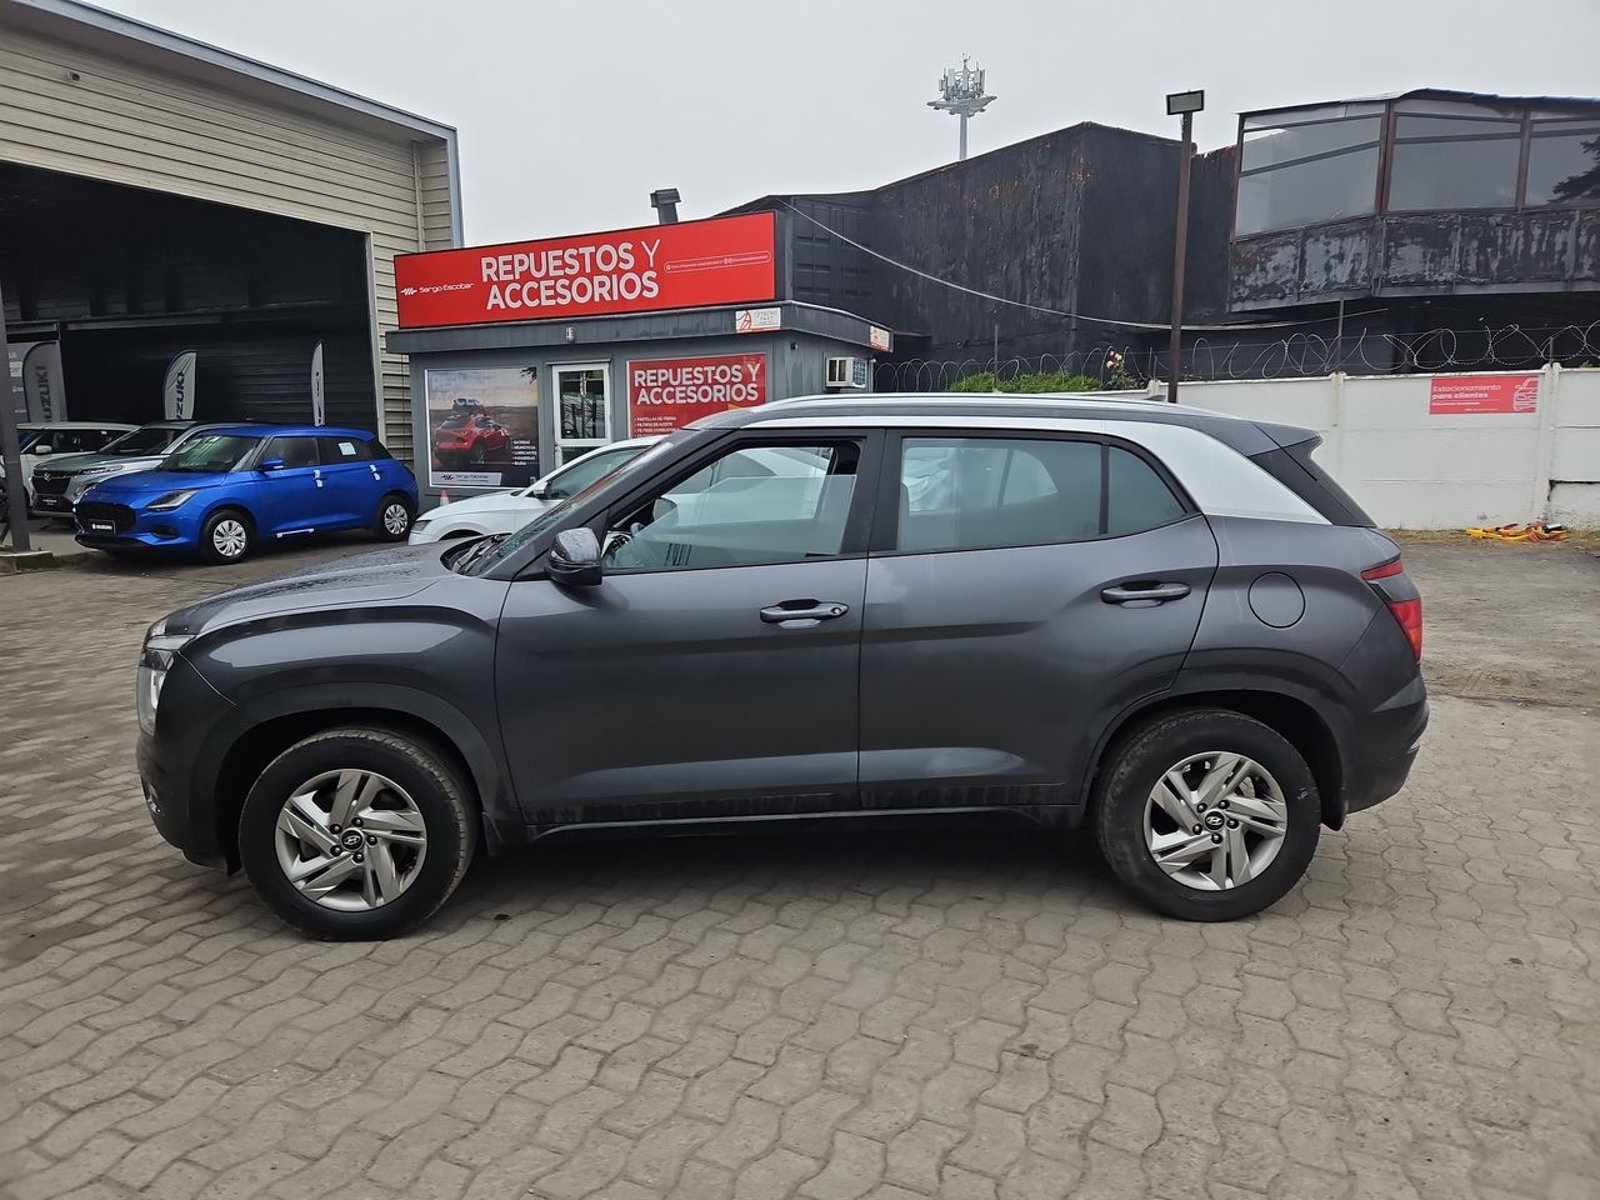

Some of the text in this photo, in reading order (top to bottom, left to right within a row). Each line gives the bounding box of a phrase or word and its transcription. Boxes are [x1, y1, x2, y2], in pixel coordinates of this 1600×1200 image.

[480, 243, 634, 282] REPUESTOS
[640, 239, 661, 268] Y
[443, 282, 475, 292] Escobar
[485, 271, 660, 311] ACCESORIOS
[634, 362, 761, 387] REPUESTOS Y
[35, 365, 52, 422] UZUKI
[637, 383, 759, 406] ACCESORIOS
[1433, 384, 1501, 392] Estacionamiento
